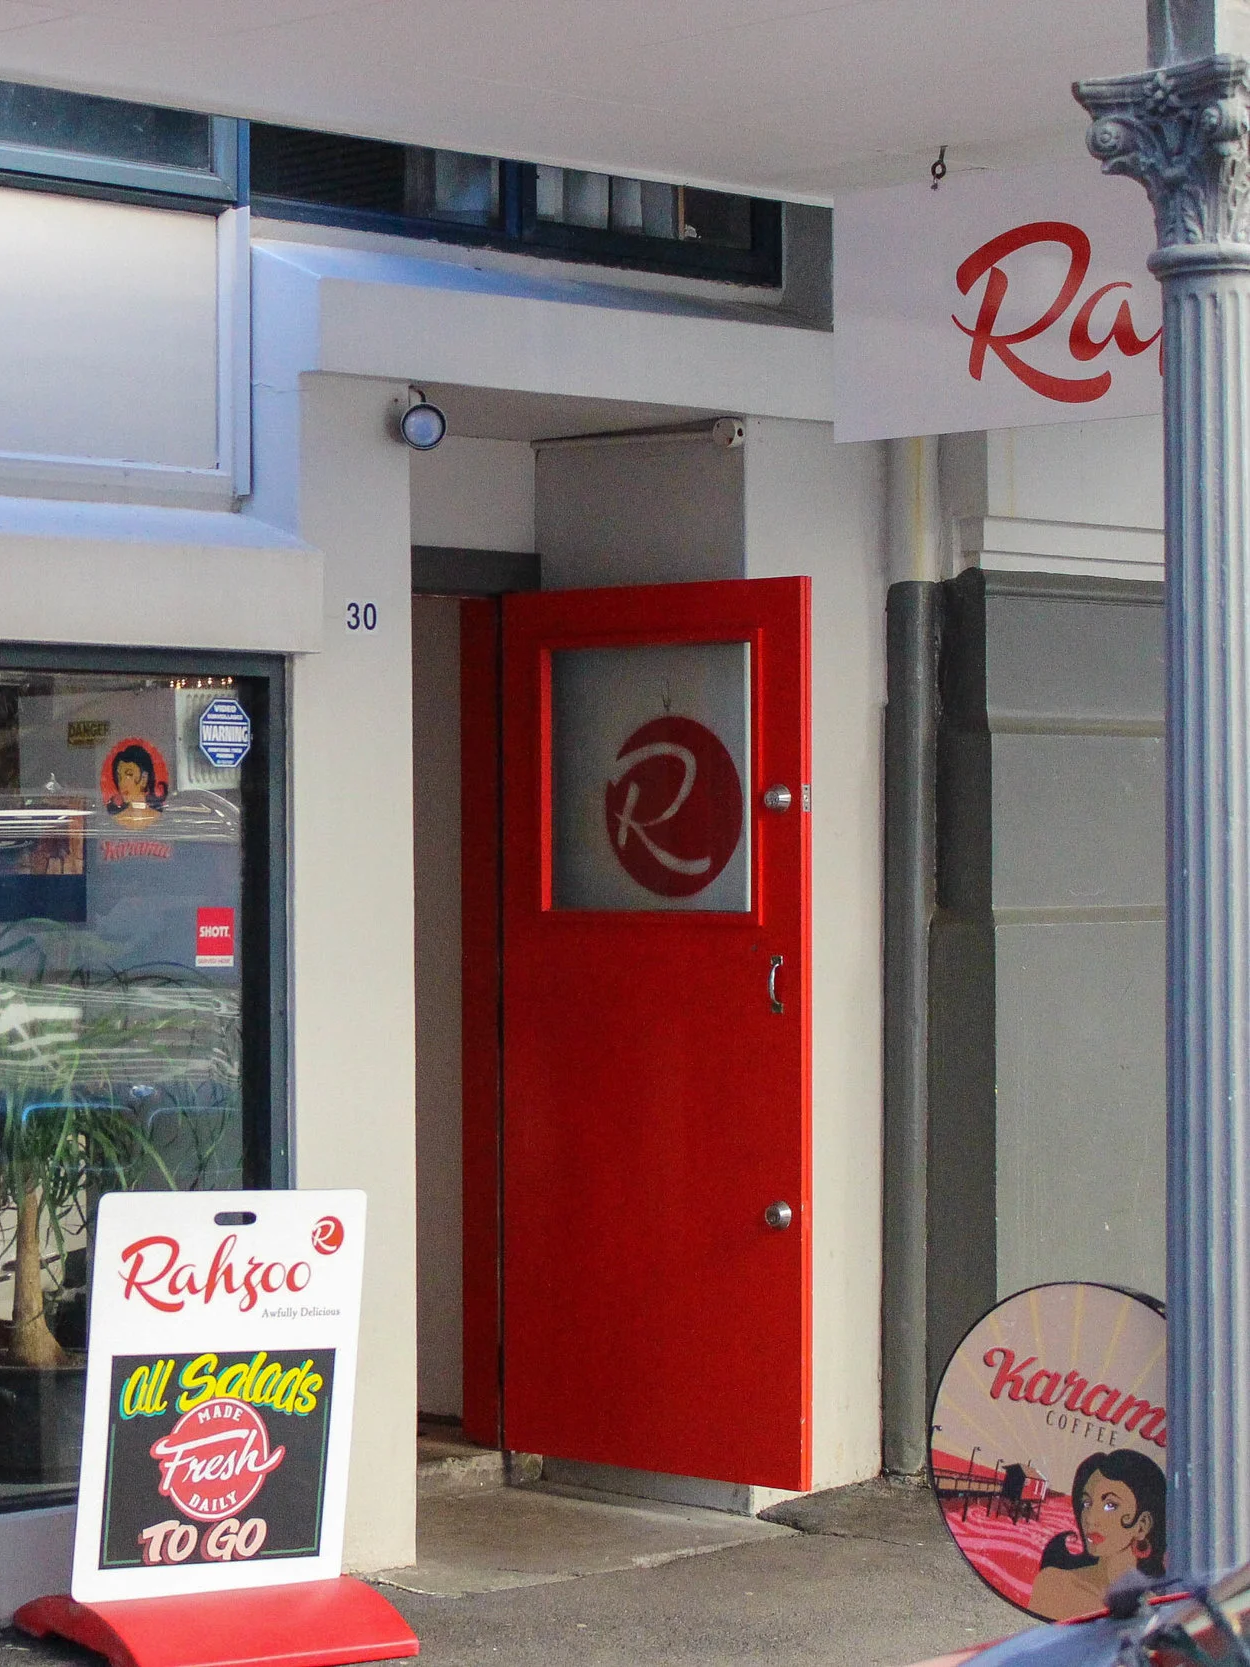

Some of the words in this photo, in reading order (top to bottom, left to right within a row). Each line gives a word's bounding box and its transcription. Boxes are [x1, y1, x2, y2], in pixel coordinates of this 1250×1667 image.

[951, 220, 1164, 403] Ra
[346, 602, 377, 630] 30
[202, 725, 249, 742] WARNING
[609, 741, 712, 876] R
[311, 1219, 339, 1252] R
[261, 1307, 299, 1320] Awfully
[300, 1306, 341, 1318] Delicious
[176, 1351, 324, 1416] Salads
[983, 1346, 1167, 1448] Karam
[196, 1406, 243, 1425] MADE
[1045, 1409, 1119, 1448] COFFEE
[154, 1428, 284, 1491] Fresh
[188, 1489, 238, 1513] DAILY
[139, 1519, 198, 1565] TO
[203, 1517, 269, 1562] GO
